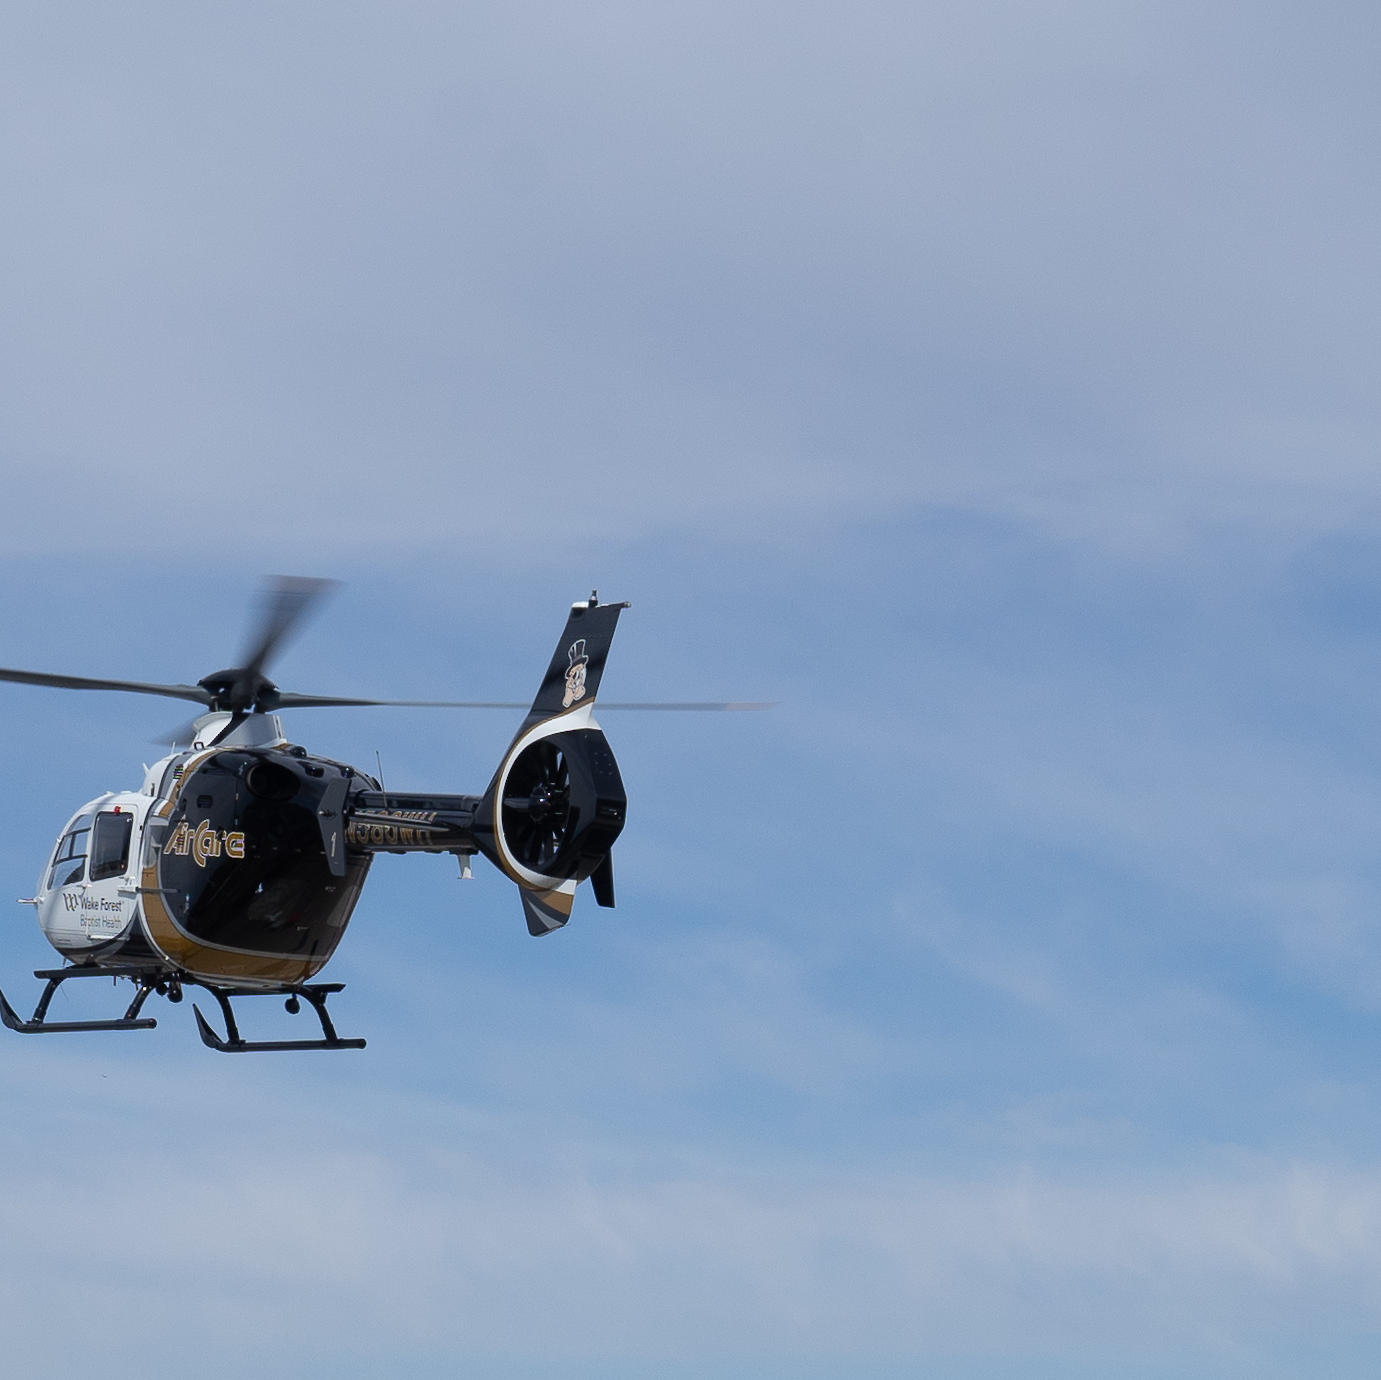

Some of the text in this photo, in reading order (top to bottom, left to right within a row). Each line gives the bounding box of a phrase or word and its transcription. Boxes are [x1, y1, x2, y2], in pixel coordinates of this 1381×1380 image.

[163, 814, 245, 867] AirCare
[330, 831, 338, 857] 1
[80, 896, 123, 912] Wake Forest
[80, 914, 122, 929] Baptist Health
